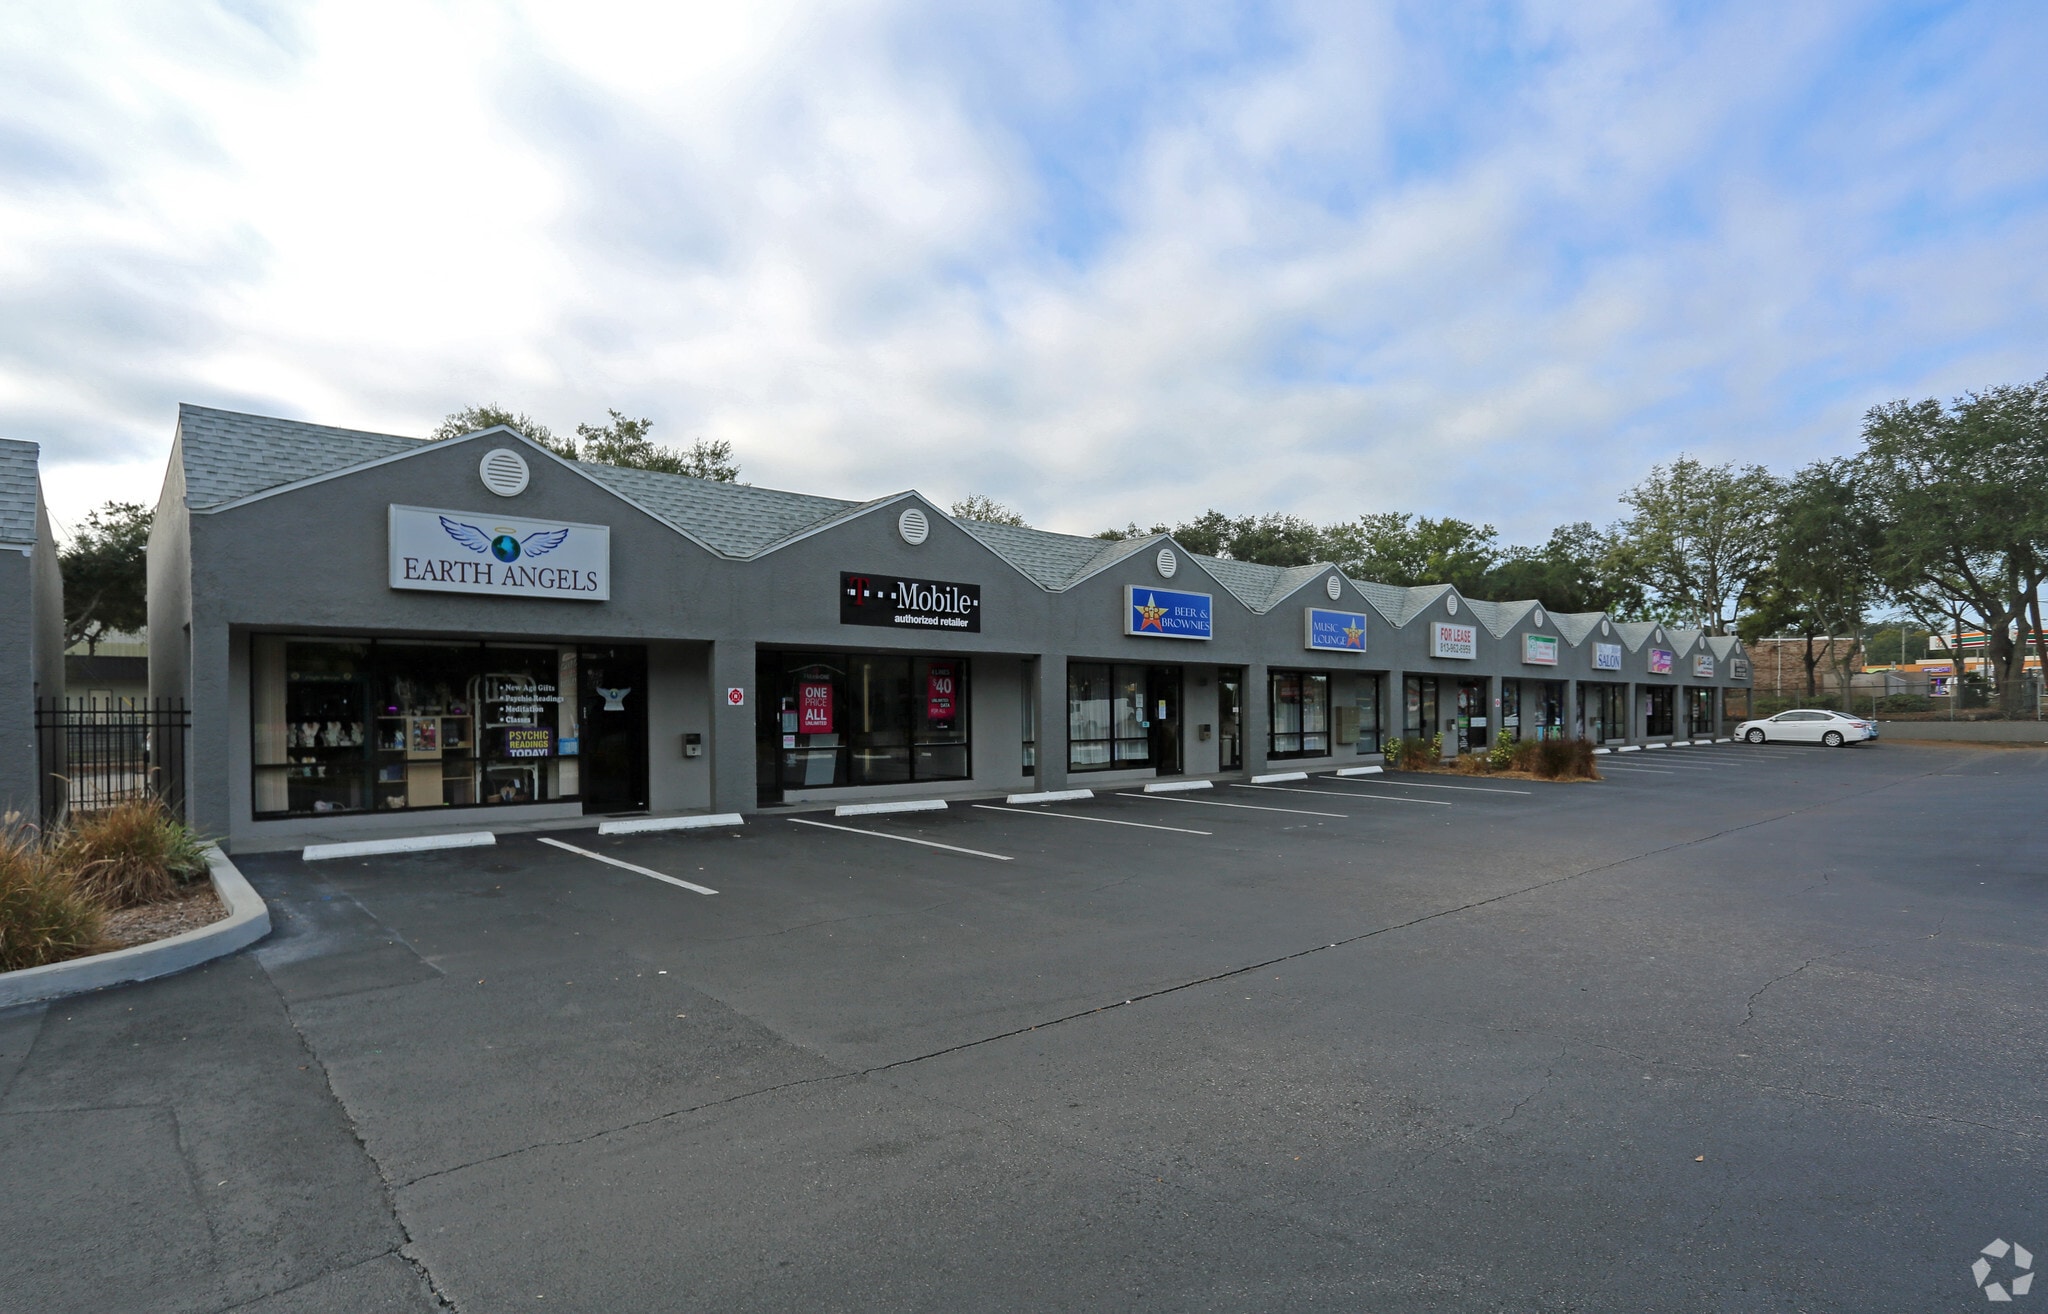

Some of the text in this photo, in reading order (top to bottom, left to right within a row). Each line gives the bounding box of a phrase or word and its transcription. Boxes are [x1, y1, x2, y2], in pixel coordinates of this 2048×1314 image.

[403, 557, 598, 592] EARTH ANGELS
[897, 581, 971, 614] Mobile
[1174, 606, 1209, 619] BEER &
[894, 614, 969, 628] authorized retailer
[1161, 617, 1210, 631] BROWNIES
[1313, 622, 1339, 633] MUSIC
[1313, 634, 1347, 646] LOUNGE
[1440, 627, 1471, 643] FOR LEASE
[1598, 654, 1620, 668] SALON
[505, 684, 556, 693] New Age Gifts
[805, 687, 828, 698] ONE
[505, 694, 564, 704] Psychic Readings
[804, 698, 828, 707] PRICE
[505, 705, 544, 713] Meditation
[805, 709, 828, 720] ALL
[505, 716, 531, 724] Classes
[509, 731, 549, 740] PSYCHIC
[509, 740, 549, 749] READINGS
